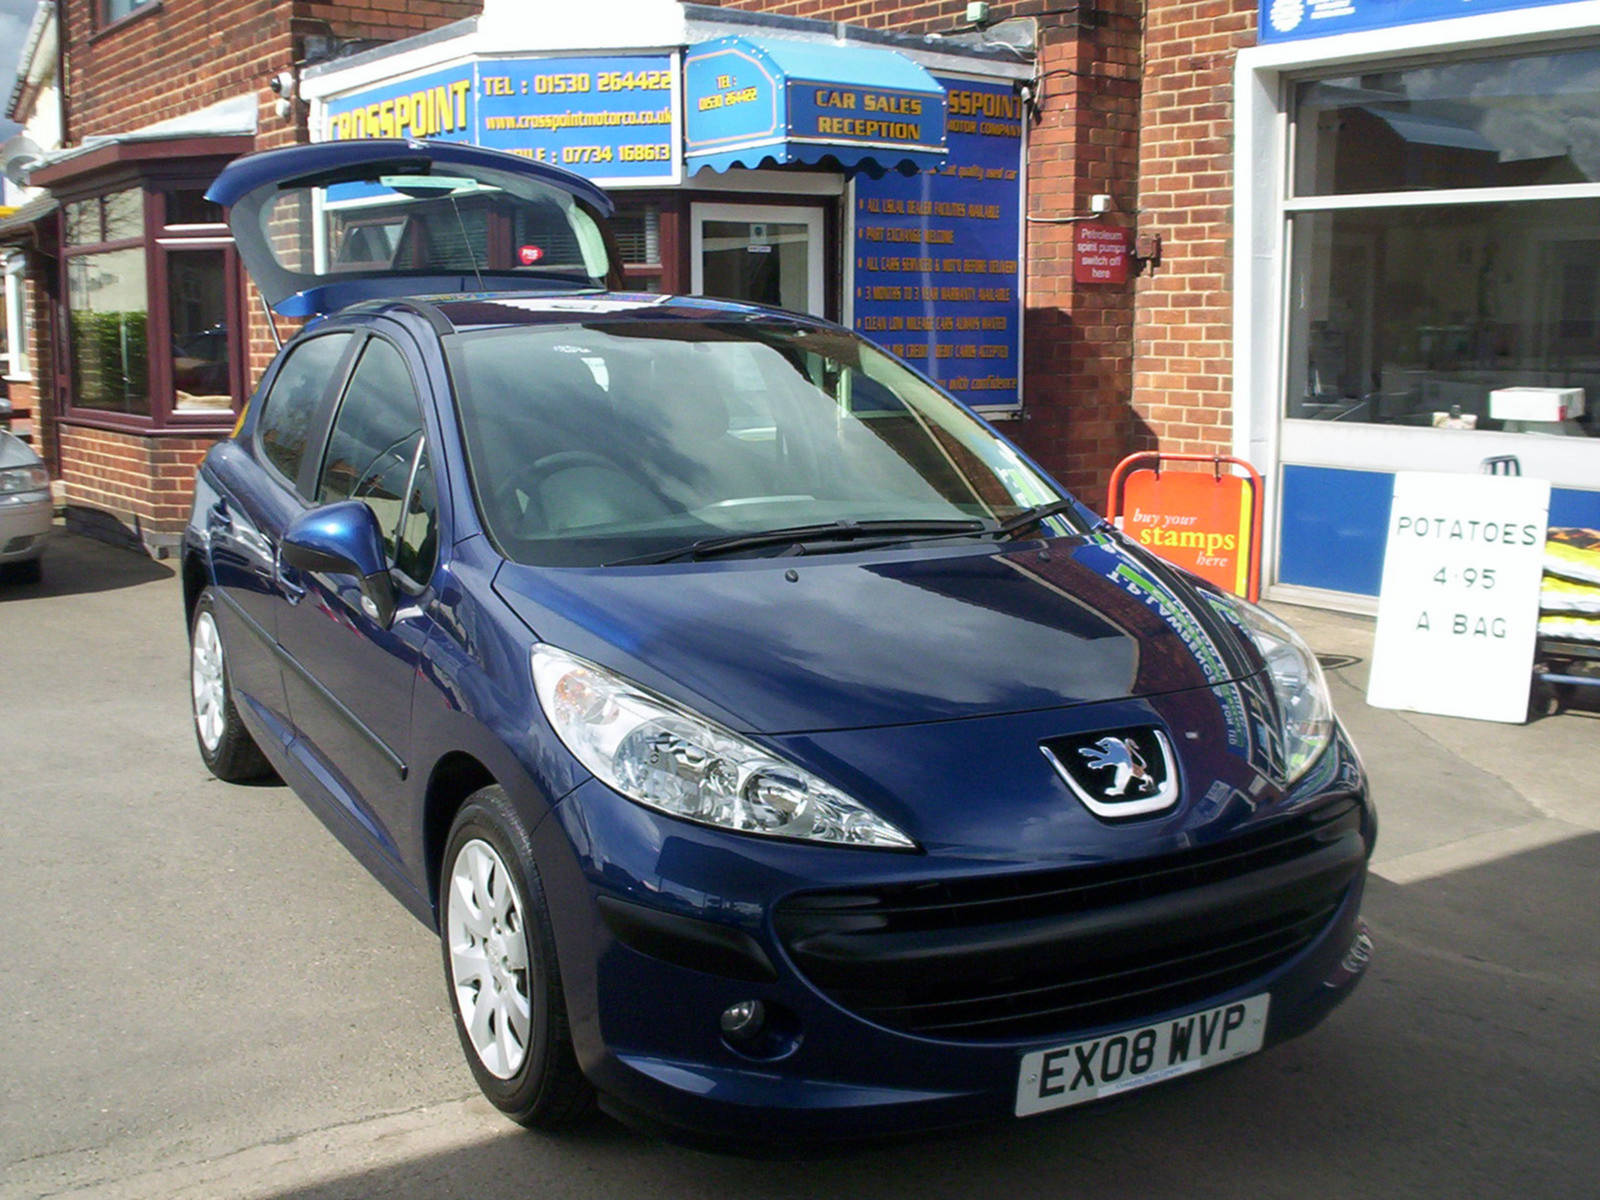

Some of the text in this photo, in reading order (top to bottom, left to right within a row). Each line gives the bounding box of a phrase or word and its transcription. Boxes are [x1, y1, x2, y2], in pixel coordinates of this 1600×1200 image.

[483, 77, 515, 95] TEL
[535, 74, 590, 93] 01530
[598, 71, 671, 91] 264422
[328, 79, 471, 140] CROSSPOINT
[816, 90, 922, 115] CAR SALES
[947, 89, 1021, 119] SSPOINT
[817, 116, 920, 140] RECEPTION
[980, 122, 1021, 136] COMPANY
[563, 146, 613, 163] 07734
[619, 144, 670, 162] 168613
[1133, 508, 1198, 527] buy your
[1140, 526, 1235, 557] stamps
[1398, 516, 1538, 546] POTATOES
[1196, 552, 1229, 567] here
[1416, 611, 1507, 639] A BAG
[1038, 1004, 1246, 1098] EX08 WVP
